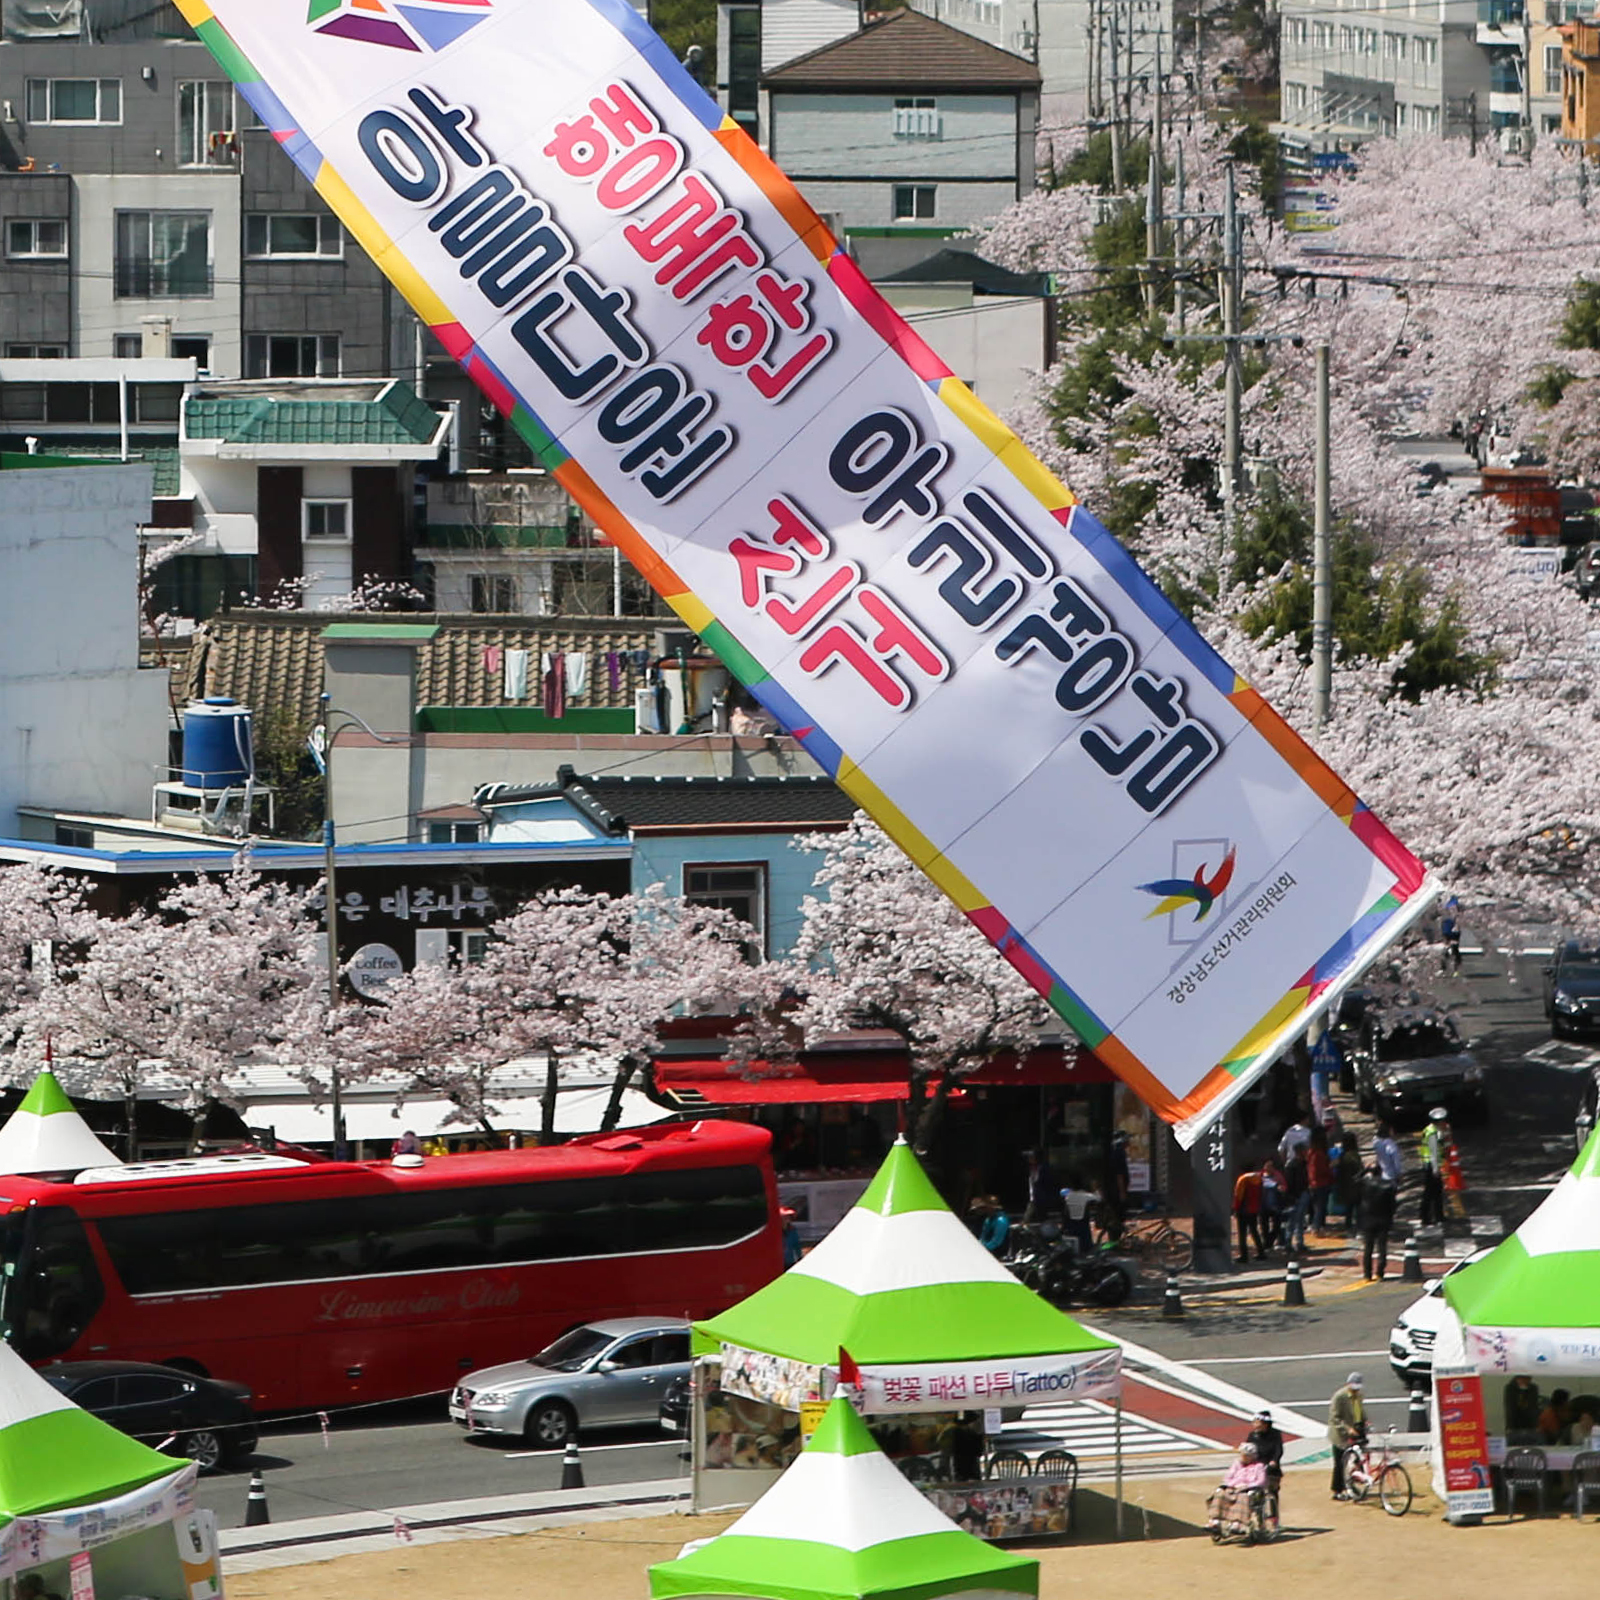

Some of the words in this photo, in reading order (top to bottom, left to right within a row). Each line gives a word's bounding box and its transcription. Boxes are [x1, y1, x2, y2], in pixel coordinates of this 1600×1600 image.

[357, 82, 735, 505] 아름다운
[728, 493, 949, 713] 선거
[542, 77, 836, 404] 행복한
[826, 406, 1226, 816] 우리경남
[1163, 869, 1298, 1005] 경상남도선거관리위원회
[355, 956, 398, 969] Coffee
[361, 973, 392, 988] Bee
[1206, 1113, 1227, 1172] 사거리
[314, 1288, 446, 1323] Limousine
[882, 1376, 923, 1403] 벚꽃
[928, 1374, 967, 1401] 패션
[973, 1365, 1078, 1396] 타투(Tattoo)
